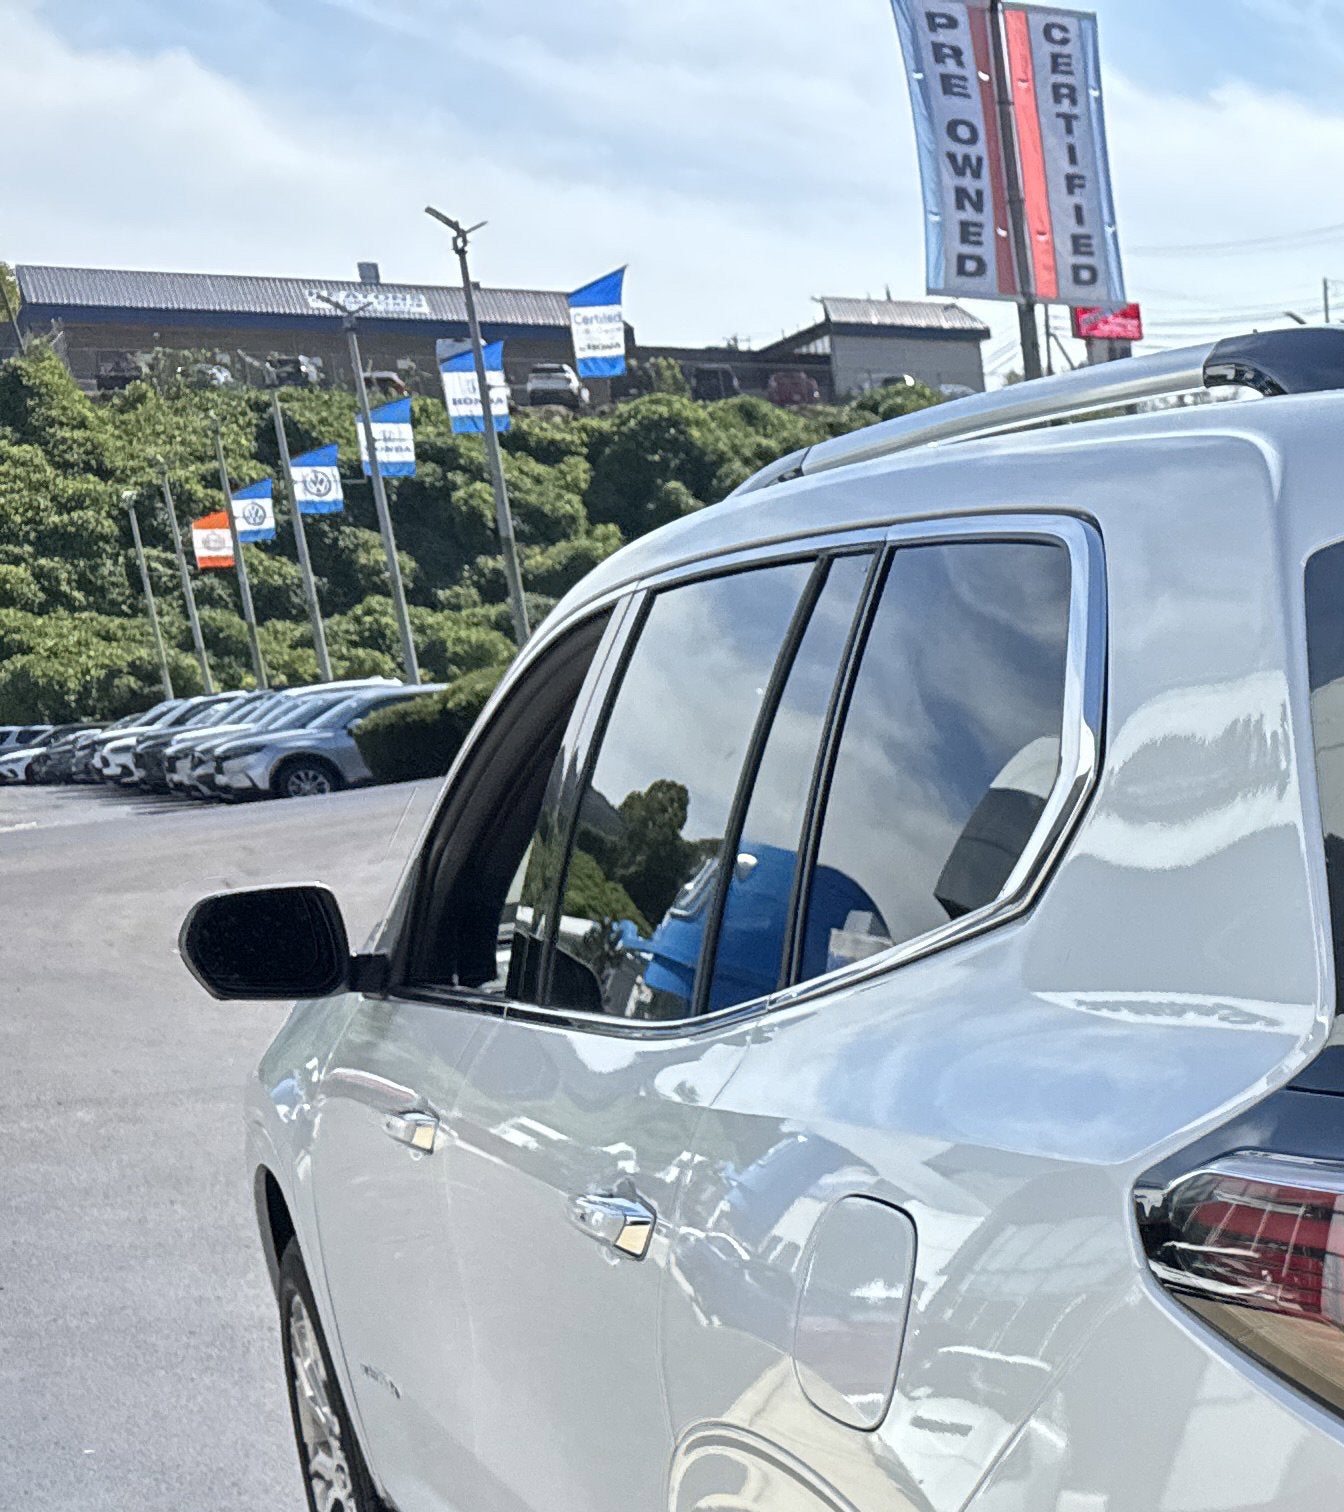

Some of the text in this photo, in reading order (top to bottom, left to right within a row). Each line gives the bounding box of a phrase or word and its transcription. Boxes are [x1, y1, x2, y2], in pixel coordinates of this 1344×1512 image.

[924, 11, 988, 277] PRE OWNED
[1042, 22, 1098, 286] CERTIFIED
[452, 396, 504, 406] HONA
